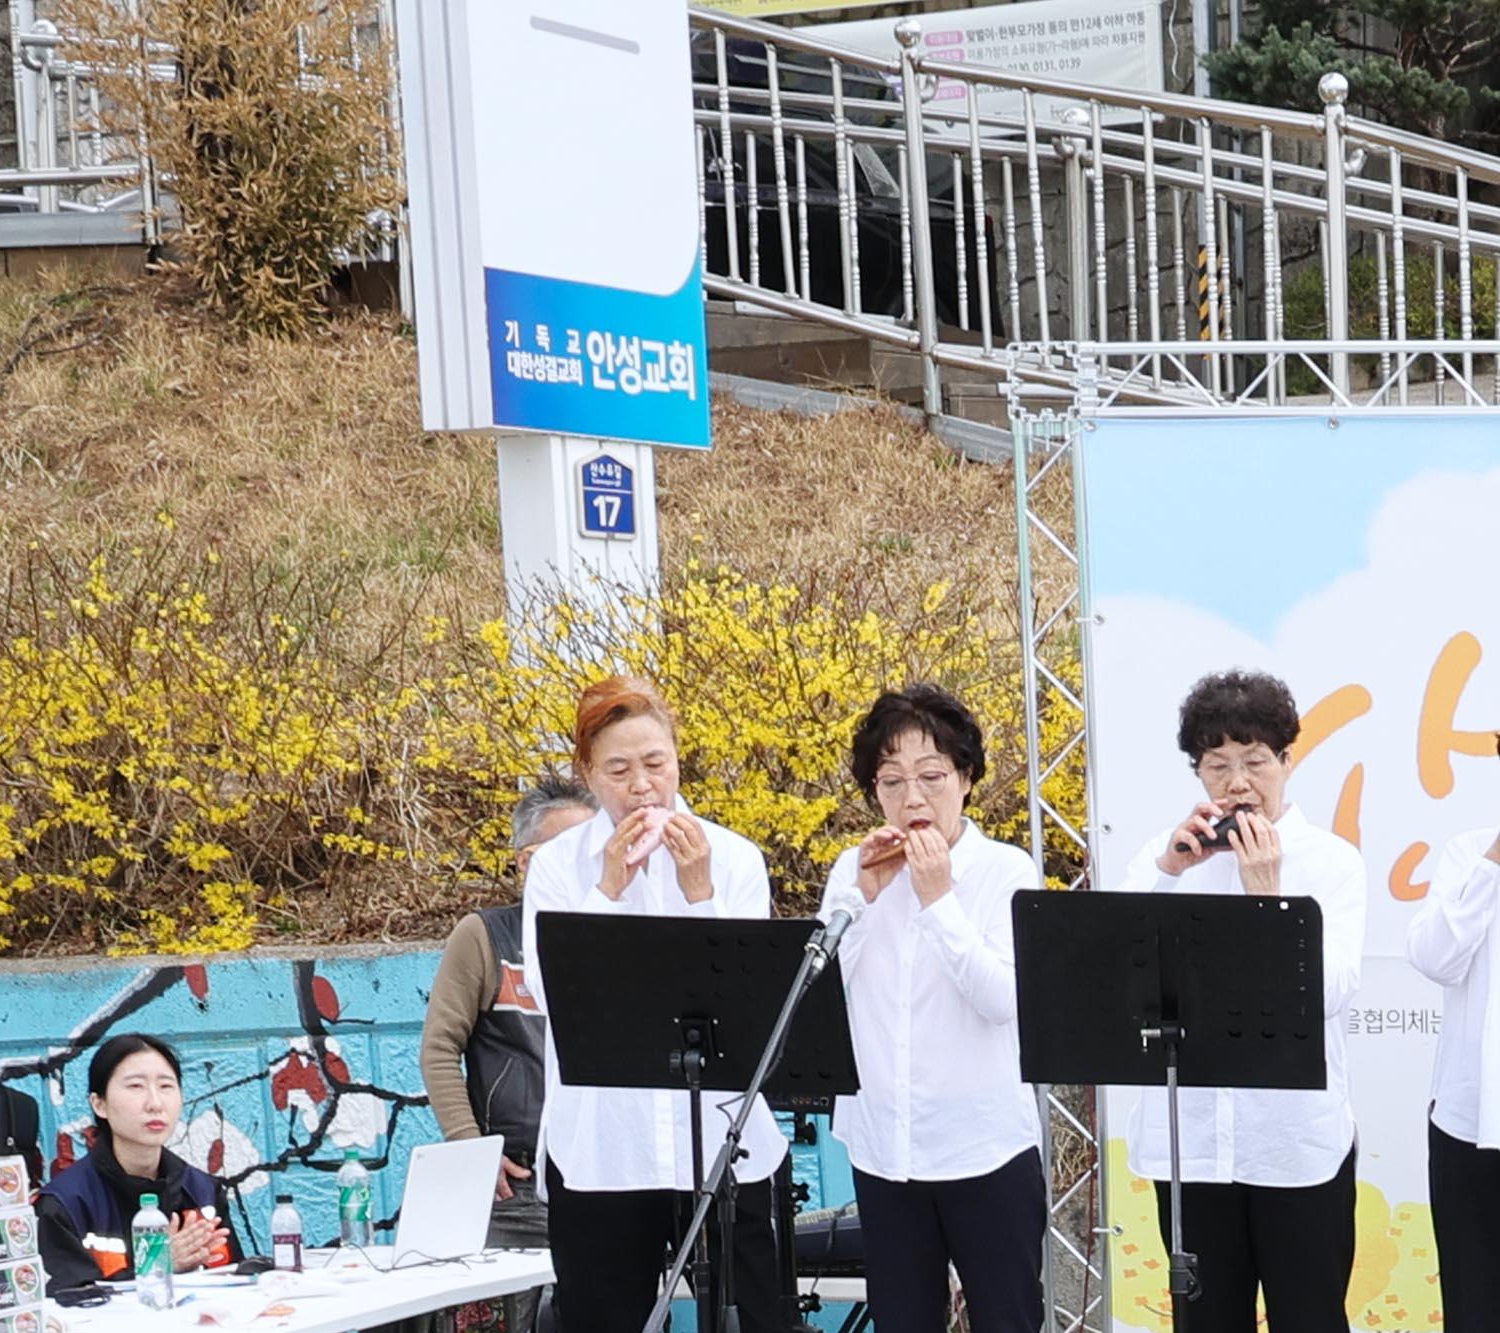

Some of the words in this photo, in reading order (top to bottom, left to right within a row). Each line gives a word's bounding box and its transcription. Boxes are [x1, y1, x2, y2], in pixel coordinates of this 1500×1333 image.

[507, 350, 584, 386] 대한성결교회
[585, 329, 697, 402] 안성교회
[592, 494, 623, 528] 17
